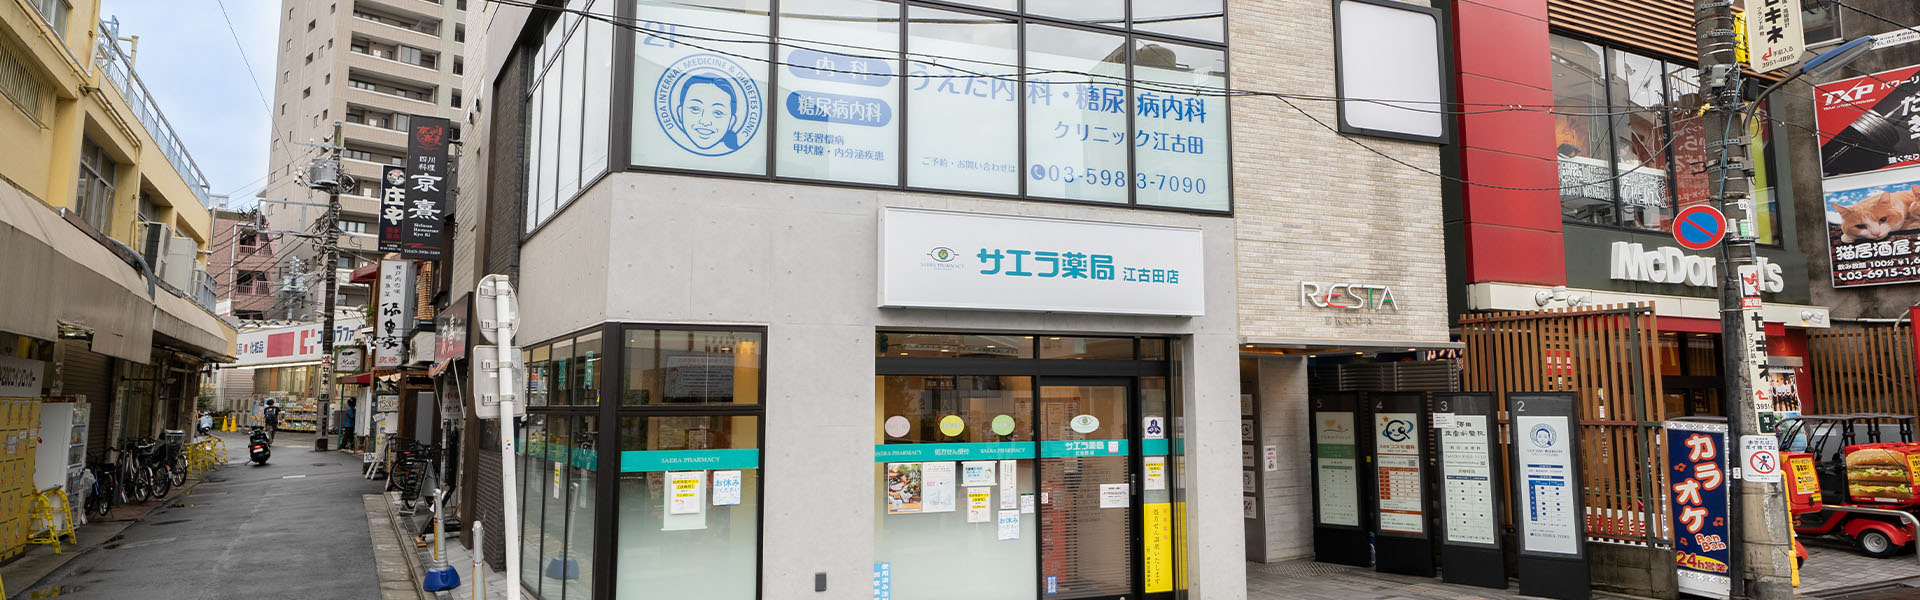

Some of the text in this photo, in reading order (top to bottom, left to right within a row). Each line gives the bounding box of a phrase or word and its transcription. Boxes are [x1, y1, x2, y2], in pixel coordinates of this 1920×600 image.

[815, 56, 868, 80] 内科
[1762, 54, 1795, 69] 3951-4895
[660, 57, 759, 138] UEDA INTERNAL MEDICINE & DIABETES CLINIC
[909, 64, 1208, 124] うえだ内科・糖尿病内科
[1822, 80, 1875, 106] TXP
[797, 94, 882, 124] 糖尿病内科
[793, 131, 845, 145] 生活習慣病
[1053, 120, 1205, 155] クリニック江古田
[793, 143, 885, 161] 甲状腺・内分泌疾患
[418, 164, 436, 172] 料理
[921, 156, 1017, 174] ご予約・お問い合わせは
[1048, 164, 1207, 194] 03-5983-7090
[1836, 239, 1912, 261] 猫居酒屋
[976, 247, 1115, 281] サエラ薬局
[1123, 266, 1180, 285] 江古田店
[1301, 281, 1399, 311] RESTA
[1376, 400, 1383, 409] 4
[1440, 401, 1448, 411] 3
[1517, 400, 1525, 411] 2
[715, 478, 740, 487] お休み
[1676, 434, 1723, 533] カラオケ
[1696, 533, 1722, 545] Ban
[1701, 540, 1727, 552] Ban
